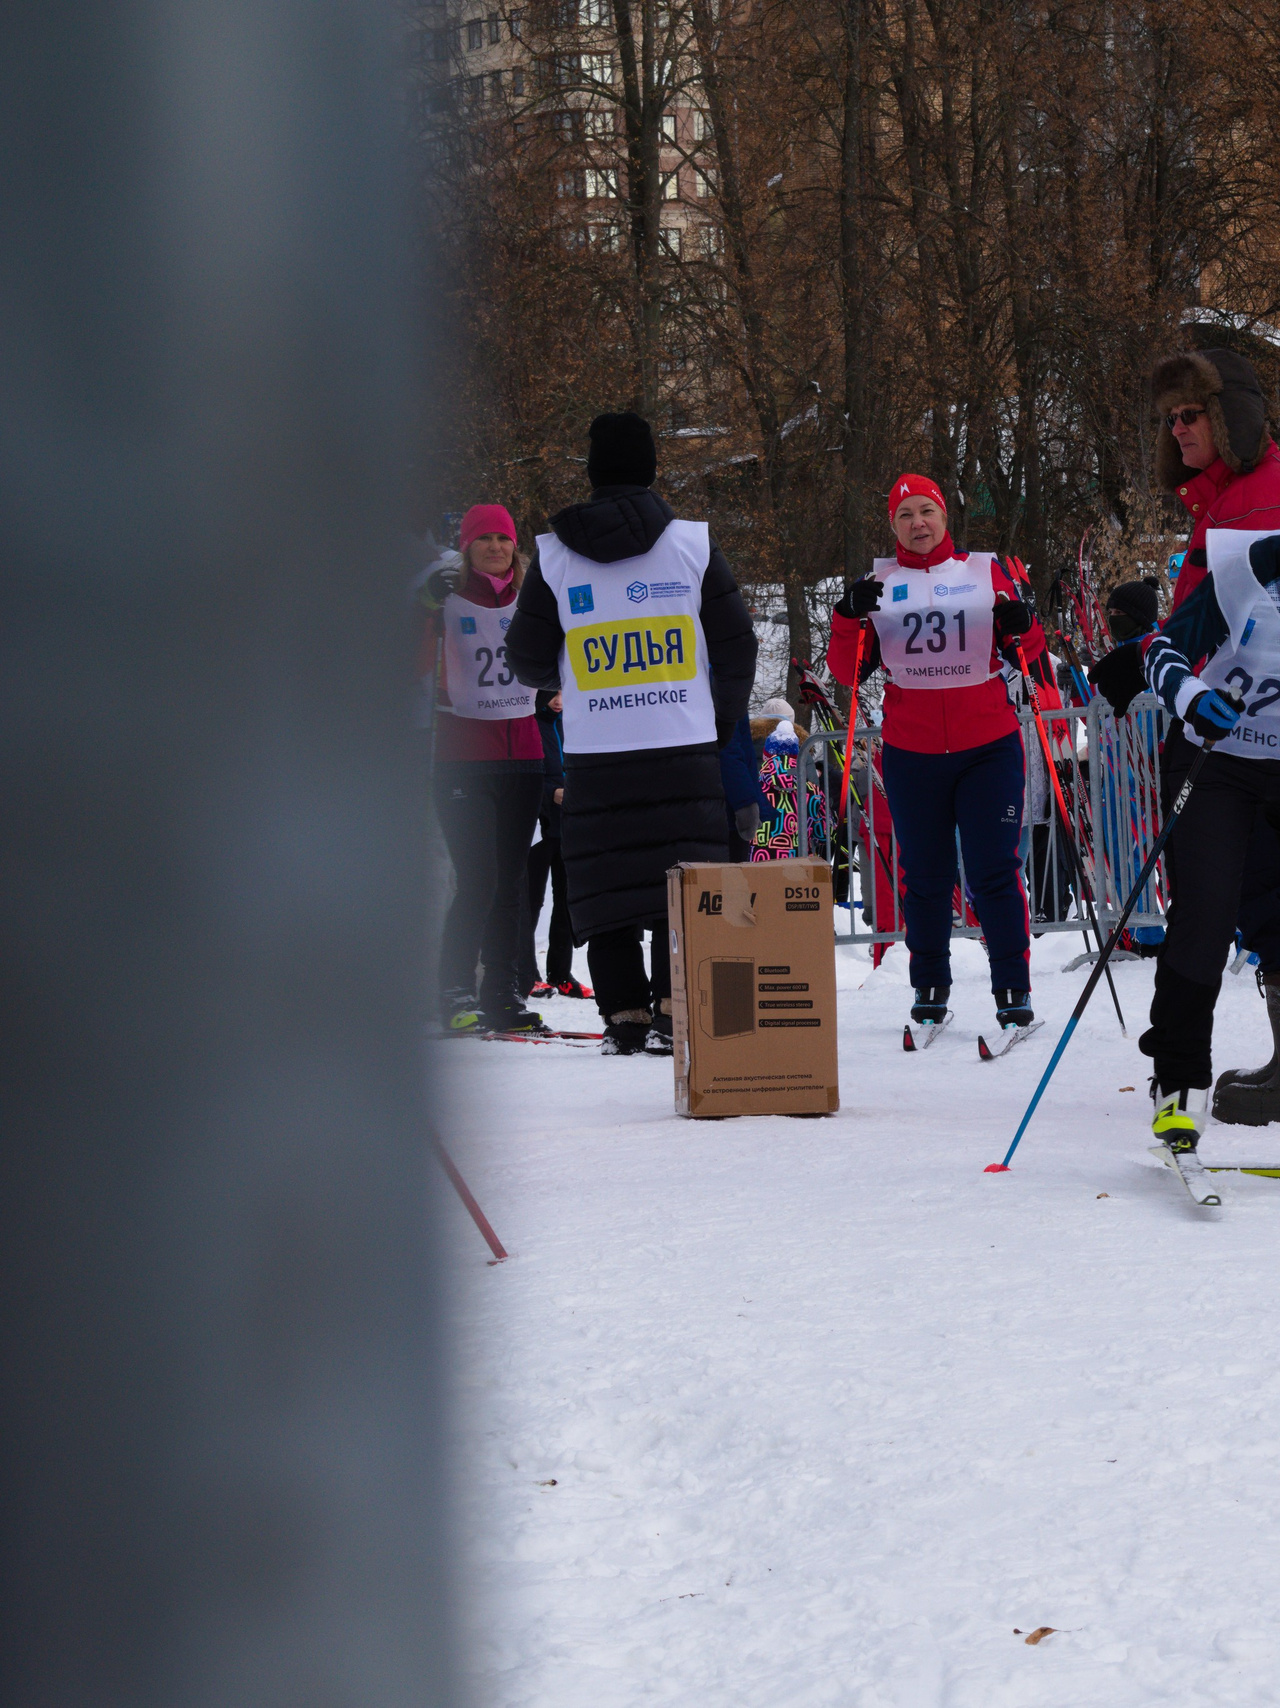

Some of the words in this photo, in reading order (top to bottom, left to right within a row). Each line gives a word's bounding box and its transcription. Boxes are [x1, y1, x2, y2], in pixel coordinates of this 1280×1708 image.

[903, 610, 966, 655] 231
[583, 628, 684, 673] СУДЬЯ
[475, 646, 515, 687] 23
[905, 664, 971, 677] РАМЕНСКОЕ
[477, 696, 530, 709] РАМЕНСКОЕ
[588, 689, 688, 712] РАМЕНСКОЕ
[784, 887, 820, 899] DS10
[711, 1087, 751, 1095] встроенным
[786, 1084, 824, 1092] усилителем
